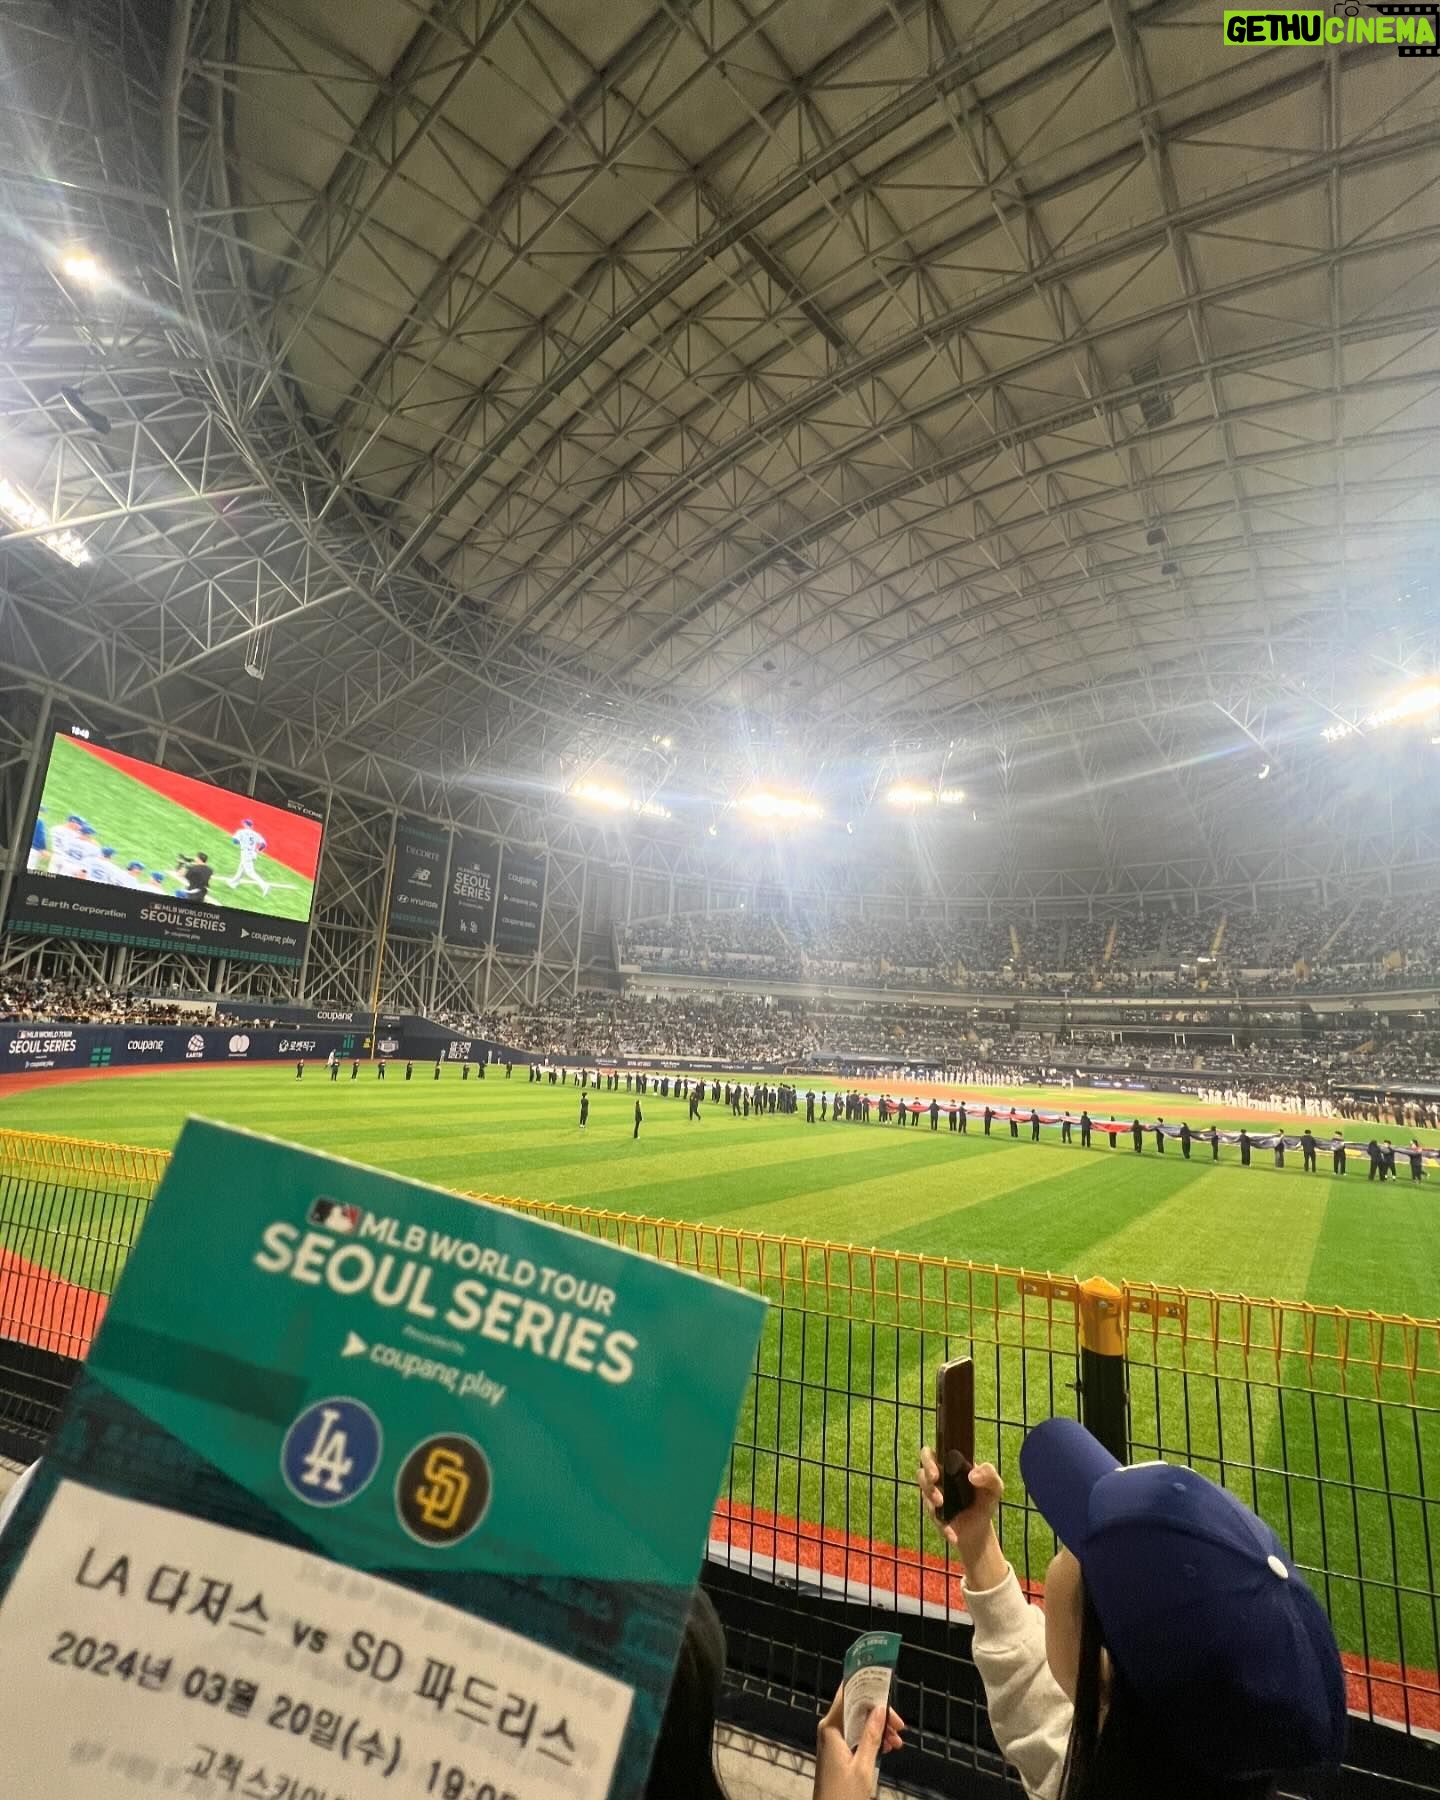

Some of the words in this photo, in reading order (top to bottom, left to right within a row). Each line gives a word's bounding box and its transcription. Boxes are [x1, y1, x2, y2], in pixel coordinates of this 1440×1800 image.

[453, 883, 491, 902] SERIES
[455, 871, 491, 891] SEOUL
[41, 898, 70, 910] Earth
[72, 903, 127, 919] Corporation
[140, 908, 183, 926] SEOUL
[185, 916, 227, 933] SERIES
[162, 905, 178, 914] MLB
[178, 908, 203, 918] WORLD
[203, 911, 220, 920] TOUR
[282, 935, 297, 947] play
[317, 1010, 353, 1023] coupang
[8, 1040, 42, 1054] SEOUL
[42, 1039, 77, 1052] SERIES
[127, 1039, 165, 1053] coupang
[358, 1212, 427, 1253] MLB
[428, 1231, 538, 1288] WORLD
[538, 1267, 618, 1317] TOUR
[253, 1220, 437, 1320] SEOUL
[445, 1279, 640, 1385] SERIES
[369, 1340, 461, 1394] coupang
[458, 1367, 507, 1407] play
[301, 1407, 353, 1493] LA
[415, 1446, 471, 1529] SD
[75, 1547, 130, 1597] LA
[146, 1564, 270, 1637] 다저스
[292, 1619, 329, 1654] vs
[345, 1630, 404, 1683] SD
[413, 1657, 577, 1767] 파드리스
[49, 1630, 173, 1692] 2024년
[182, 1666, 260, 1719] 03월
[267, 1697, 403, 1778] 20일(수)
[184, 1744, 345, 1800] 고척스카
